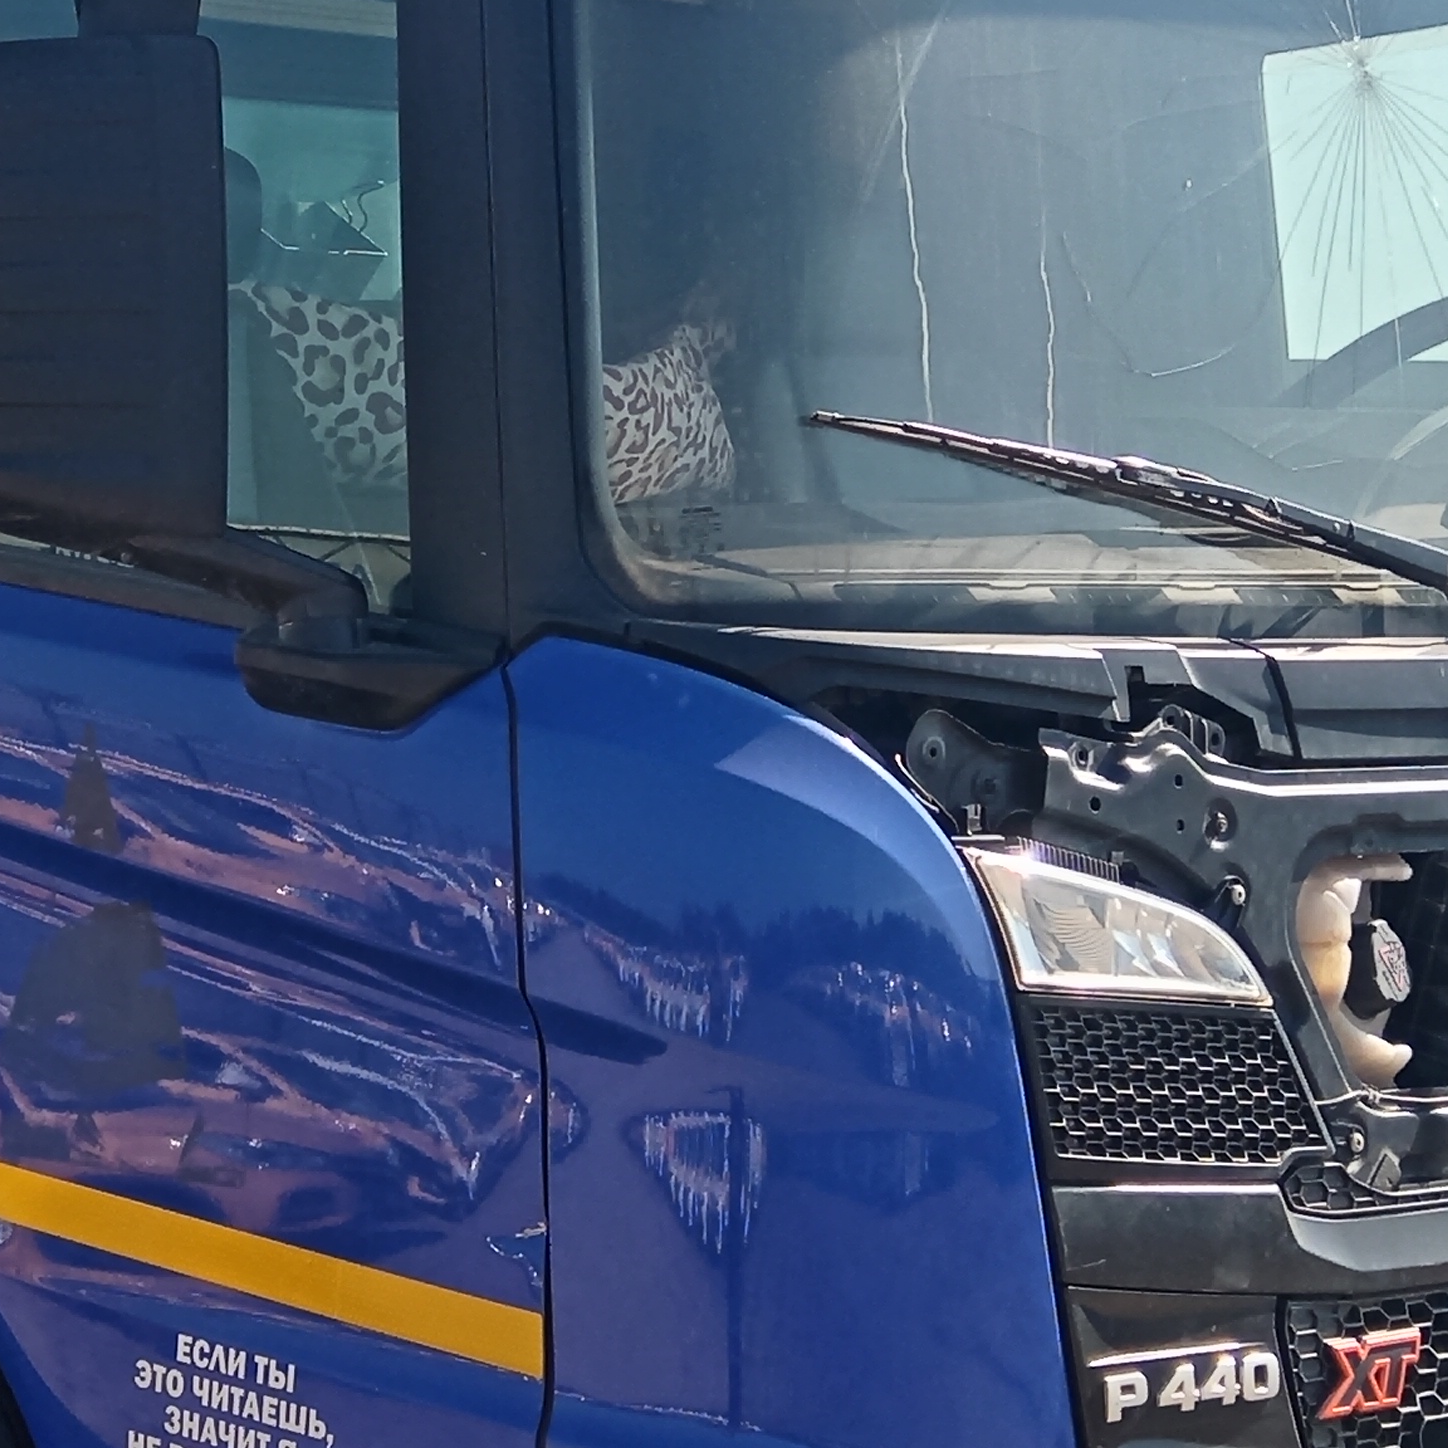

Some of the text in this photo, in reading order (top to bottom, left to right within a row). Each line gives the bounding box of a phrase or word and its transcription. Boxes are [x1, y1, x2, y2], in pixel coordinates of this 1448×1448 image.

[134, 1359, 185, 1398] ЭТО
[176, 1333, 296, 1393] ЕСЛИ ТЫ
[1104, 1351, 1280, 1424] P 440
[1316, 1327, 1421, 1420] XT
